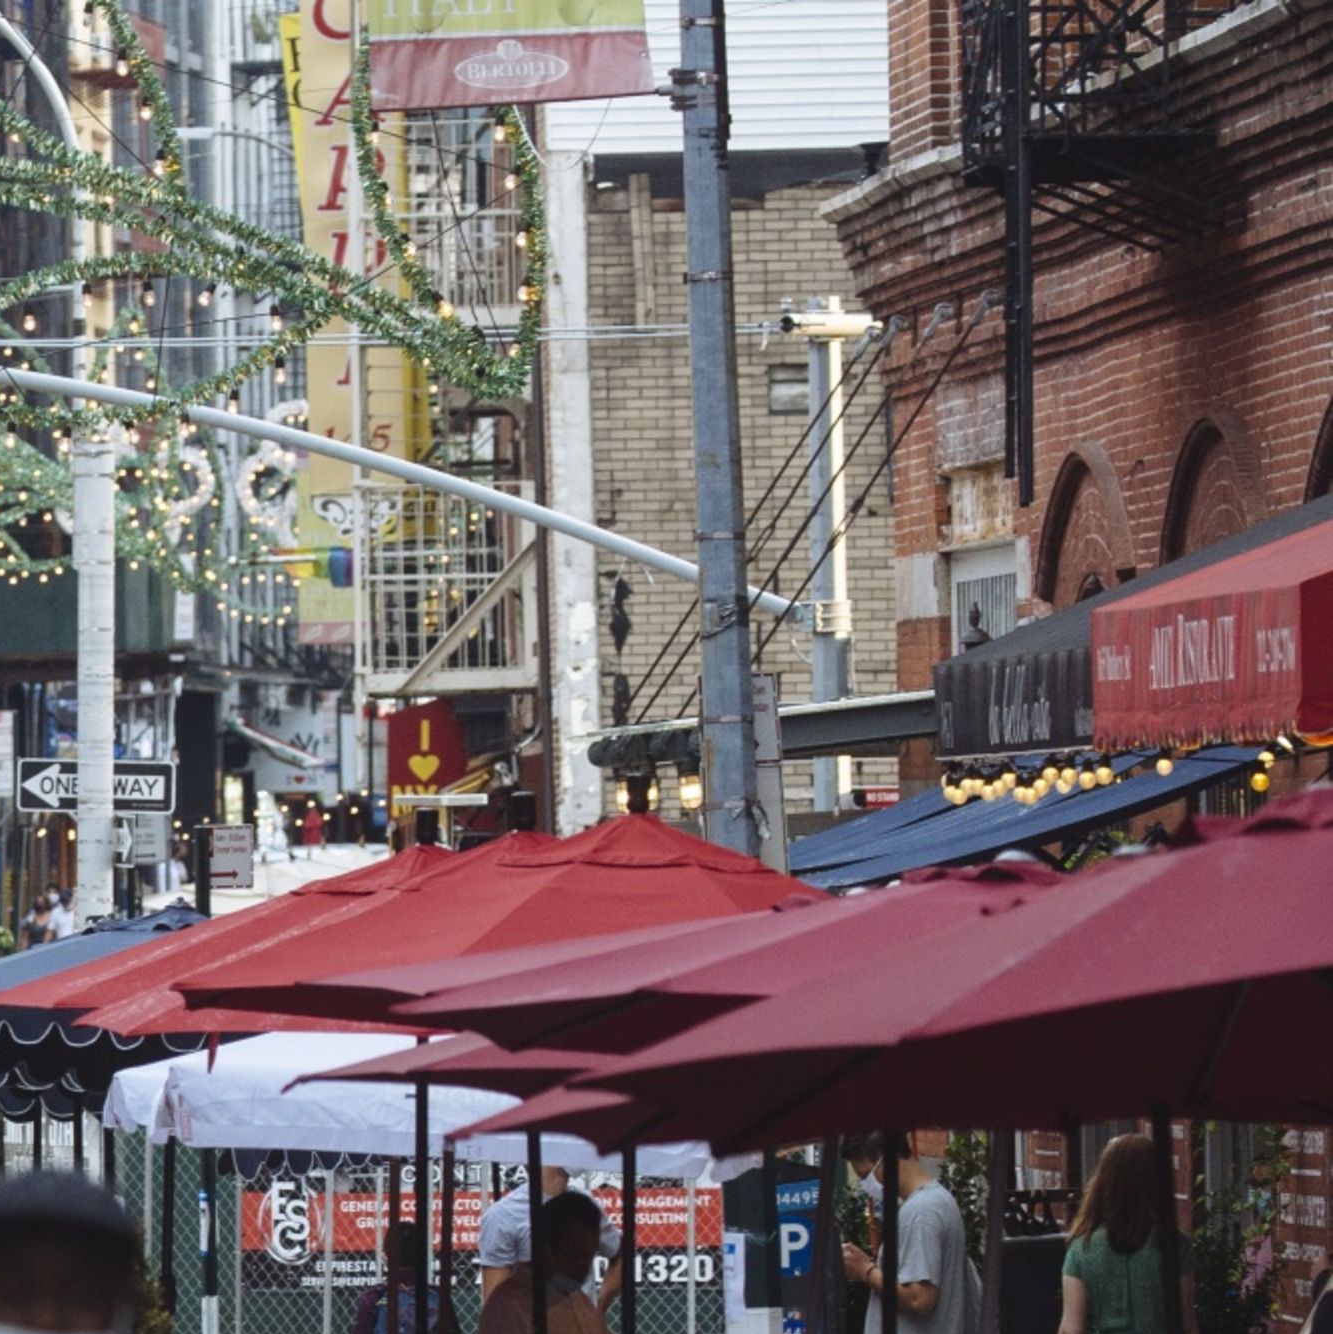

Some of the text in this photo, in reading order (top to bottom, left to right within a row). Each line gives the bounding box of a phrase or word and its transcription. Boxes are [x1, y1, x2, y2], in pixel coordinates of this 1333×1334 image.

[39, 775, 78, 796] ONE
[113, 776, 160, 797] WAY
[780, 1222, 810, 1269] P
